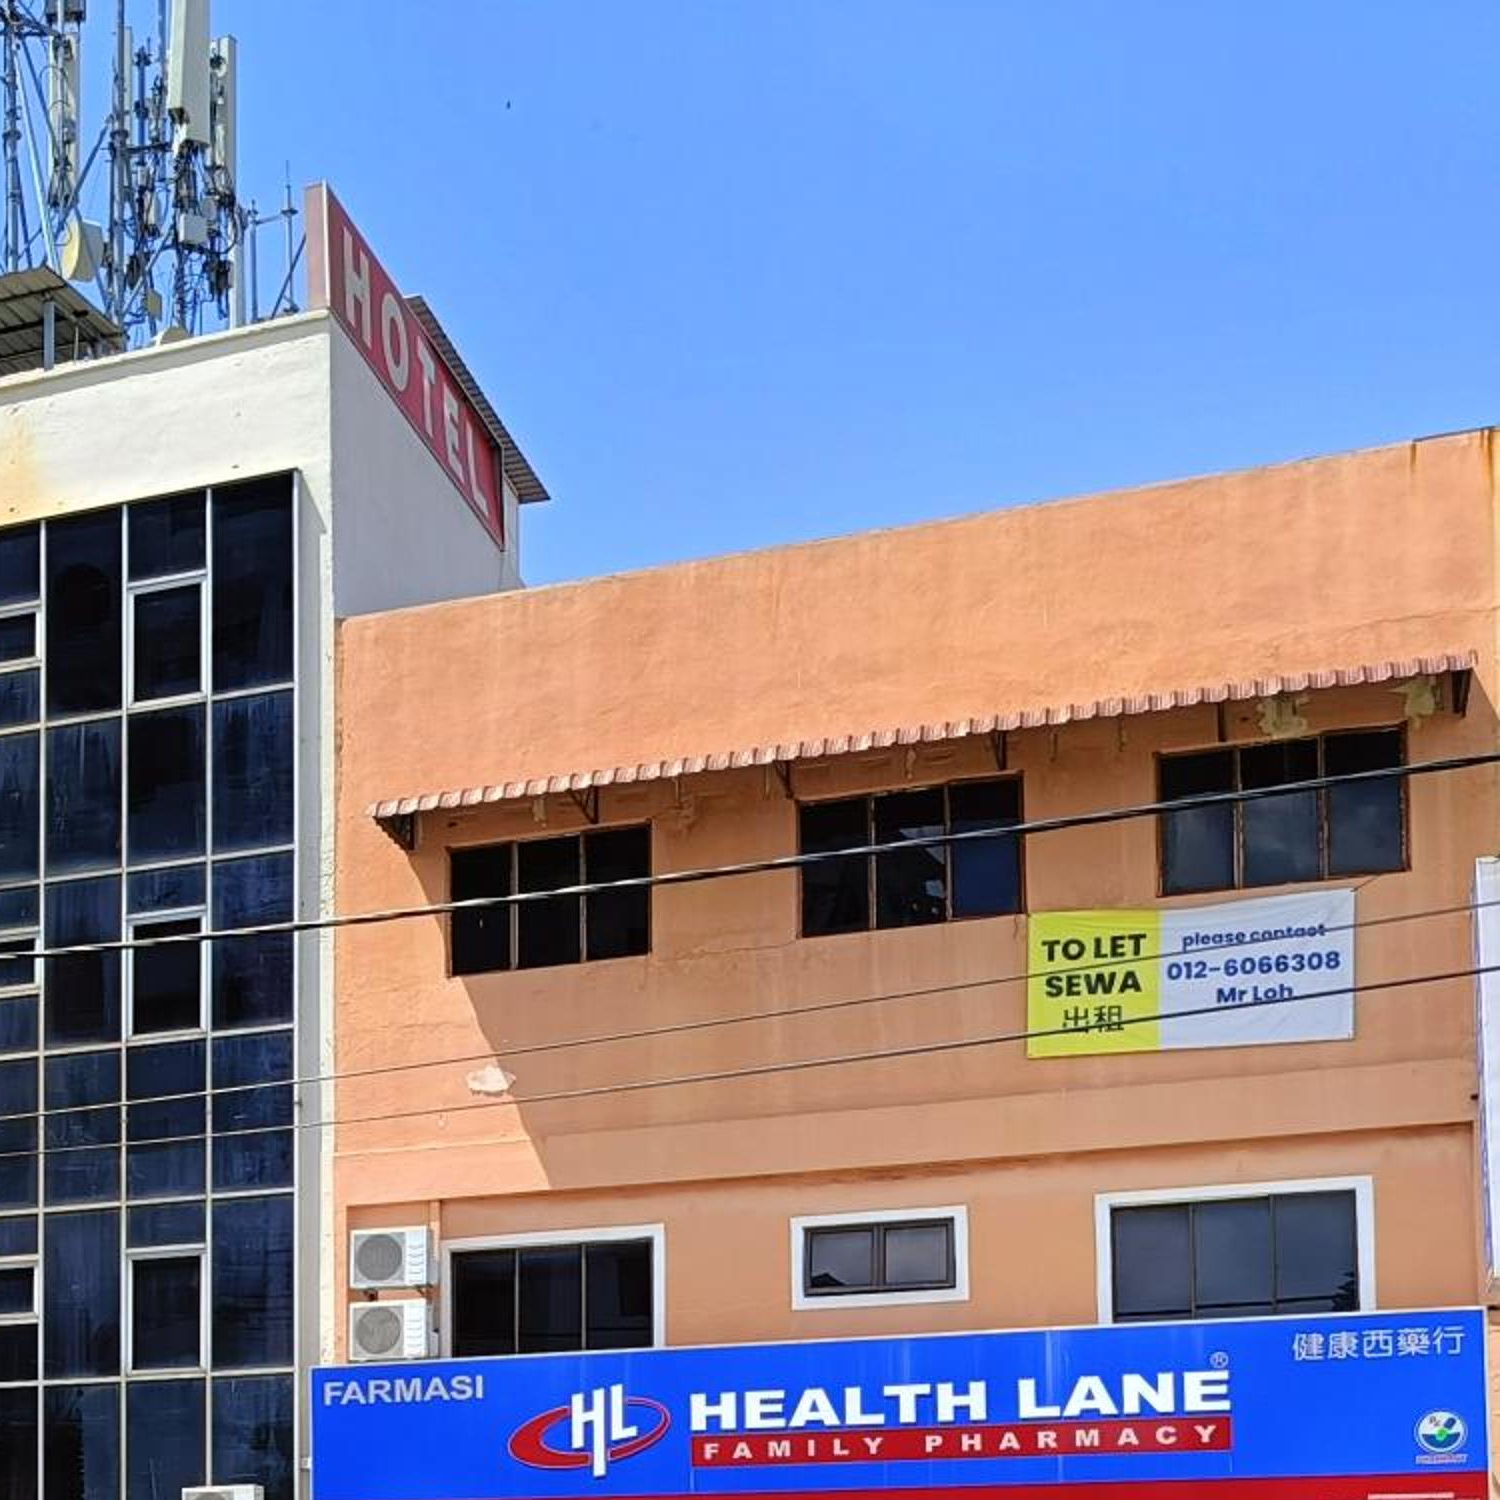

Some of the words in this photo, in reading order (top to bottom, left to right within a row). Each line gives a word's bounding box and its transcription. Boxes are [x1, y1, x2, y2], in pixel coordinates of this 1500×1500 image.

[342, 224, 490, 518] HOTEL
[1041, 938, 1086, 963] TO
[1093, 933, 1147, 960] LET
[1182, 929, 1247, 953] please
[1250, 922, 1327, 944] contact
[1167, 950, 1341, 981] 012-6066308
[1044, 970, 1142, 999] SEWA
[1216, 986, 1247, 1005] Mr
[1252, 982, 1295, 1003] Loh
[1062, 1004, 1125, 1034] 出租
[1291, 1325, 1466, 1361] 健康西藥行
[323, 1374, 485, 1406] FARMASI
[689, 1379, 988, 1432] HEALTH
[1017, 1369, 1232, 1420] LANE
[570, 1382, 638, 1478] HL
[703, 1436, 884, 1461] FAMILY
[924, 1423, 1217, 1453] PHARMACY
